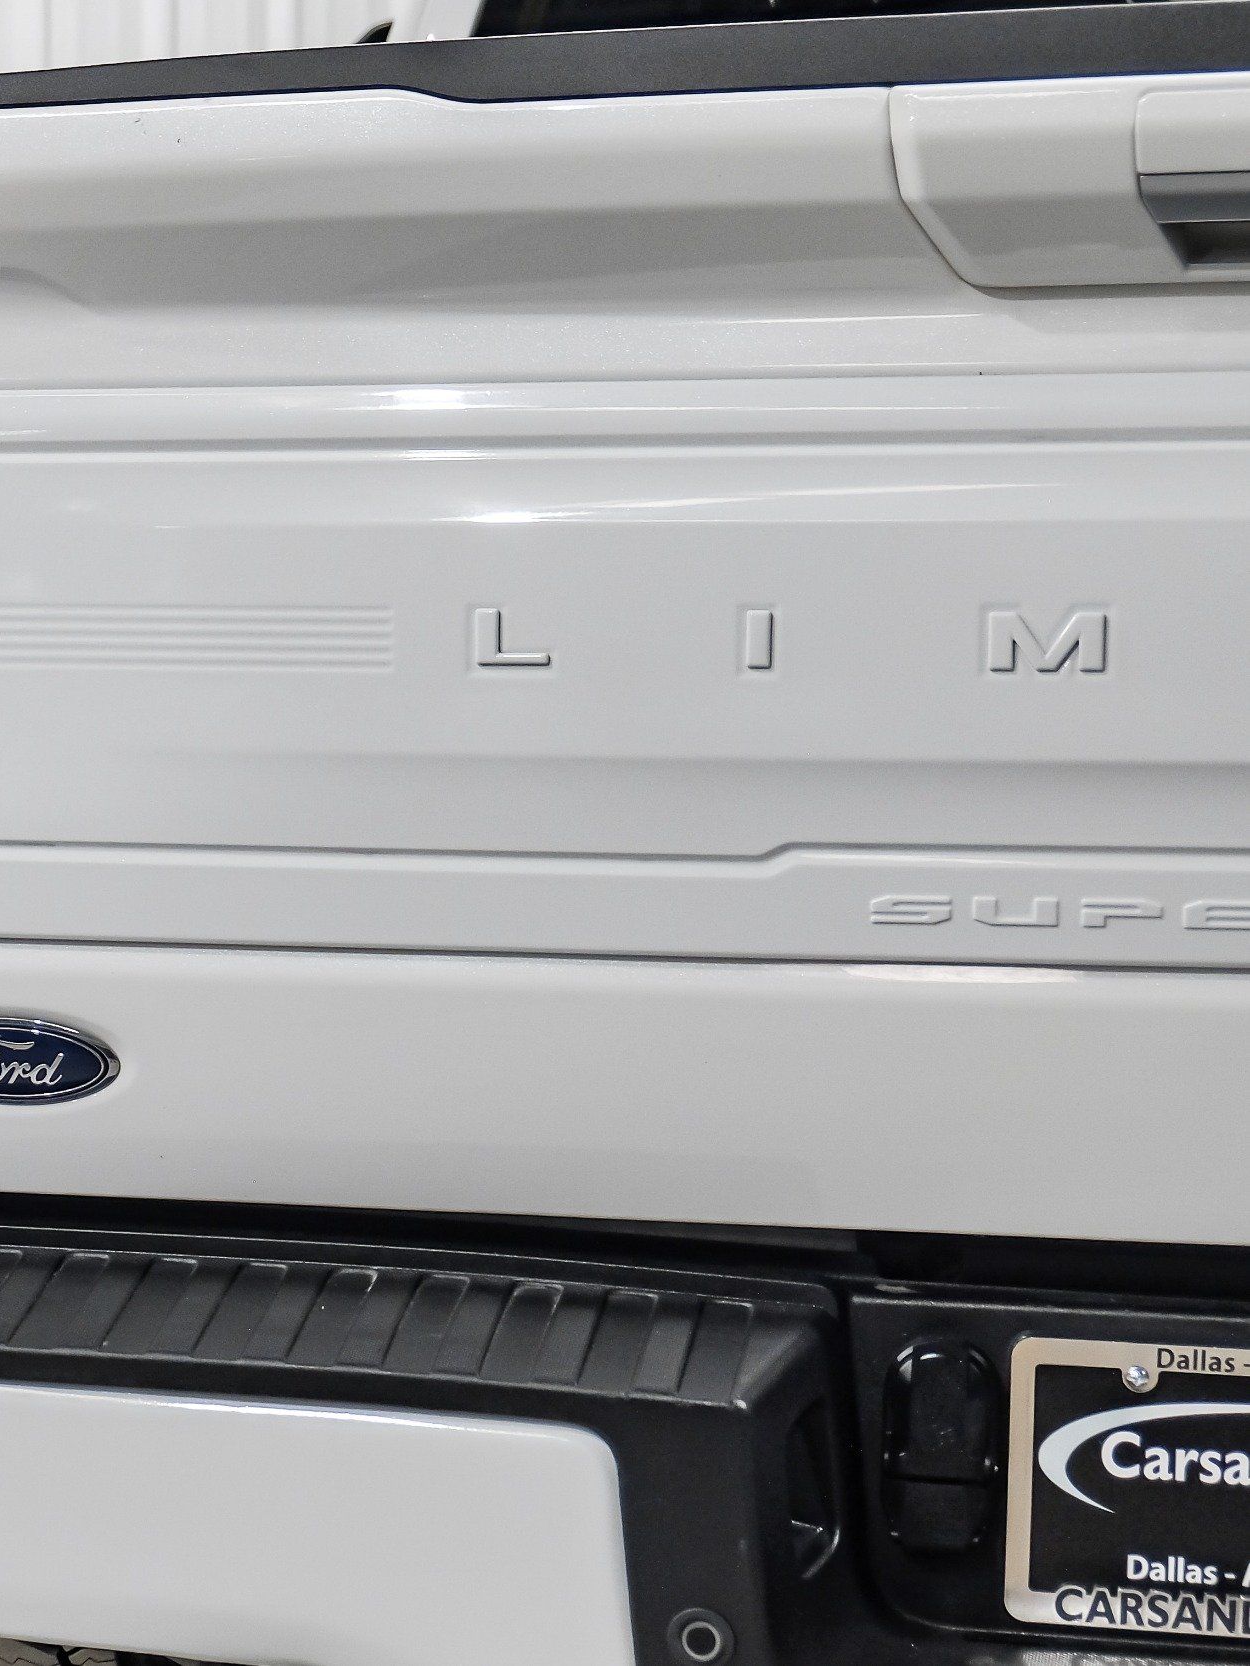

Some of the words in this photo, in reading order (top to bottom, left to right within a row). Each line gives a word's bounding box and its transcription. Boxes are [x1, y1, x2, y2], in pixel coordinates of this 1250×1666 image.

[475, 607, 1108, 674] LIM
[870, 894, 1250, 931] SUPE
[1156, 1347, 1236, 1373] Dallas
[1100, 1430, 1250, 1486] Carsa
[1126, 1553, 1219, 1585] Dallas
[1055, 1587, 1250, 1634] CARSAN
